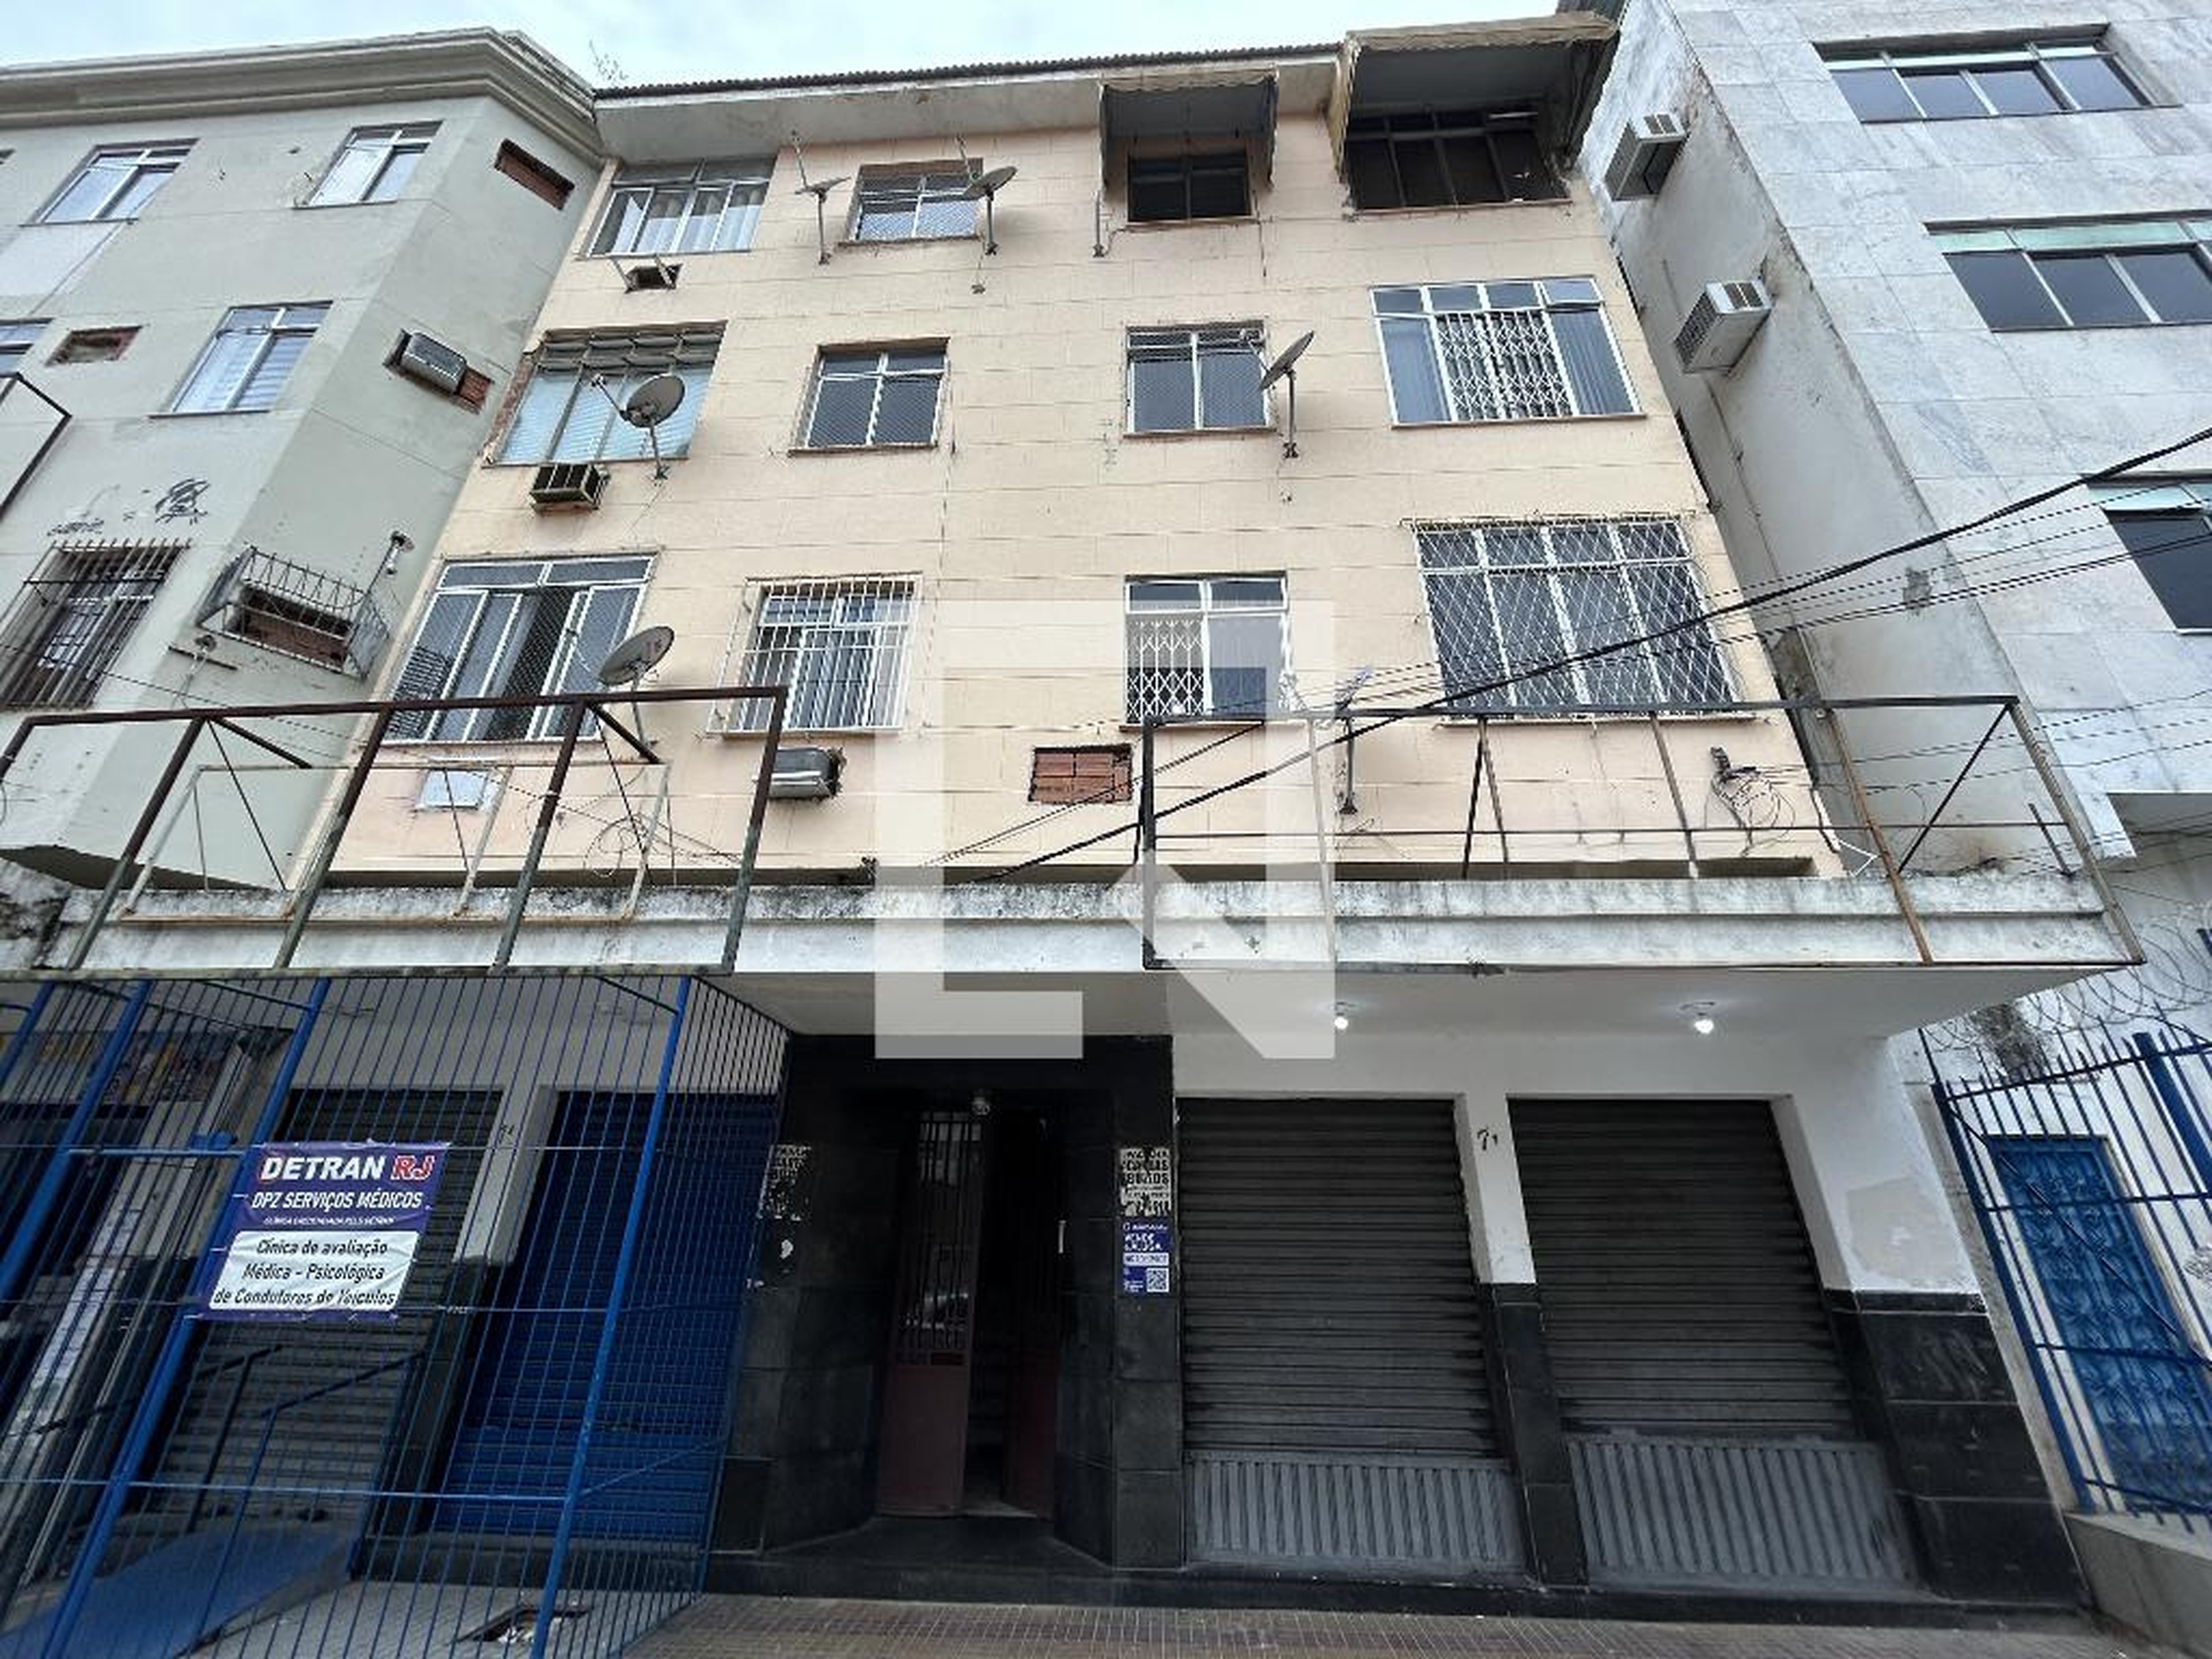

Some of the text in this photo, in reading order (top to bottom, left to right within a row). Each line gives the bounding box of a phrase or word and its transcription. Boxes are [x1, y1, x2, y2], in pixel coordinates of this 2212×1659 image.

[260, 1155, 435, 1180] DETRAN RJ
[282, 1191, 354, 1212] SERVIÇOS
[355, 1187, 424, 1209] MÉDICOS
[301, 1240, 318, 1254] de
[321, 1238, 388, 1258] avaliação
[242, 1263, 291, 1279] Médica
[306, 1263, 386, 1284] Psicológica
[213, 1289, 231, 1304] de
[234, 1288, 313, 1305] Condutores
[317, 1289, 334, 1305] de
